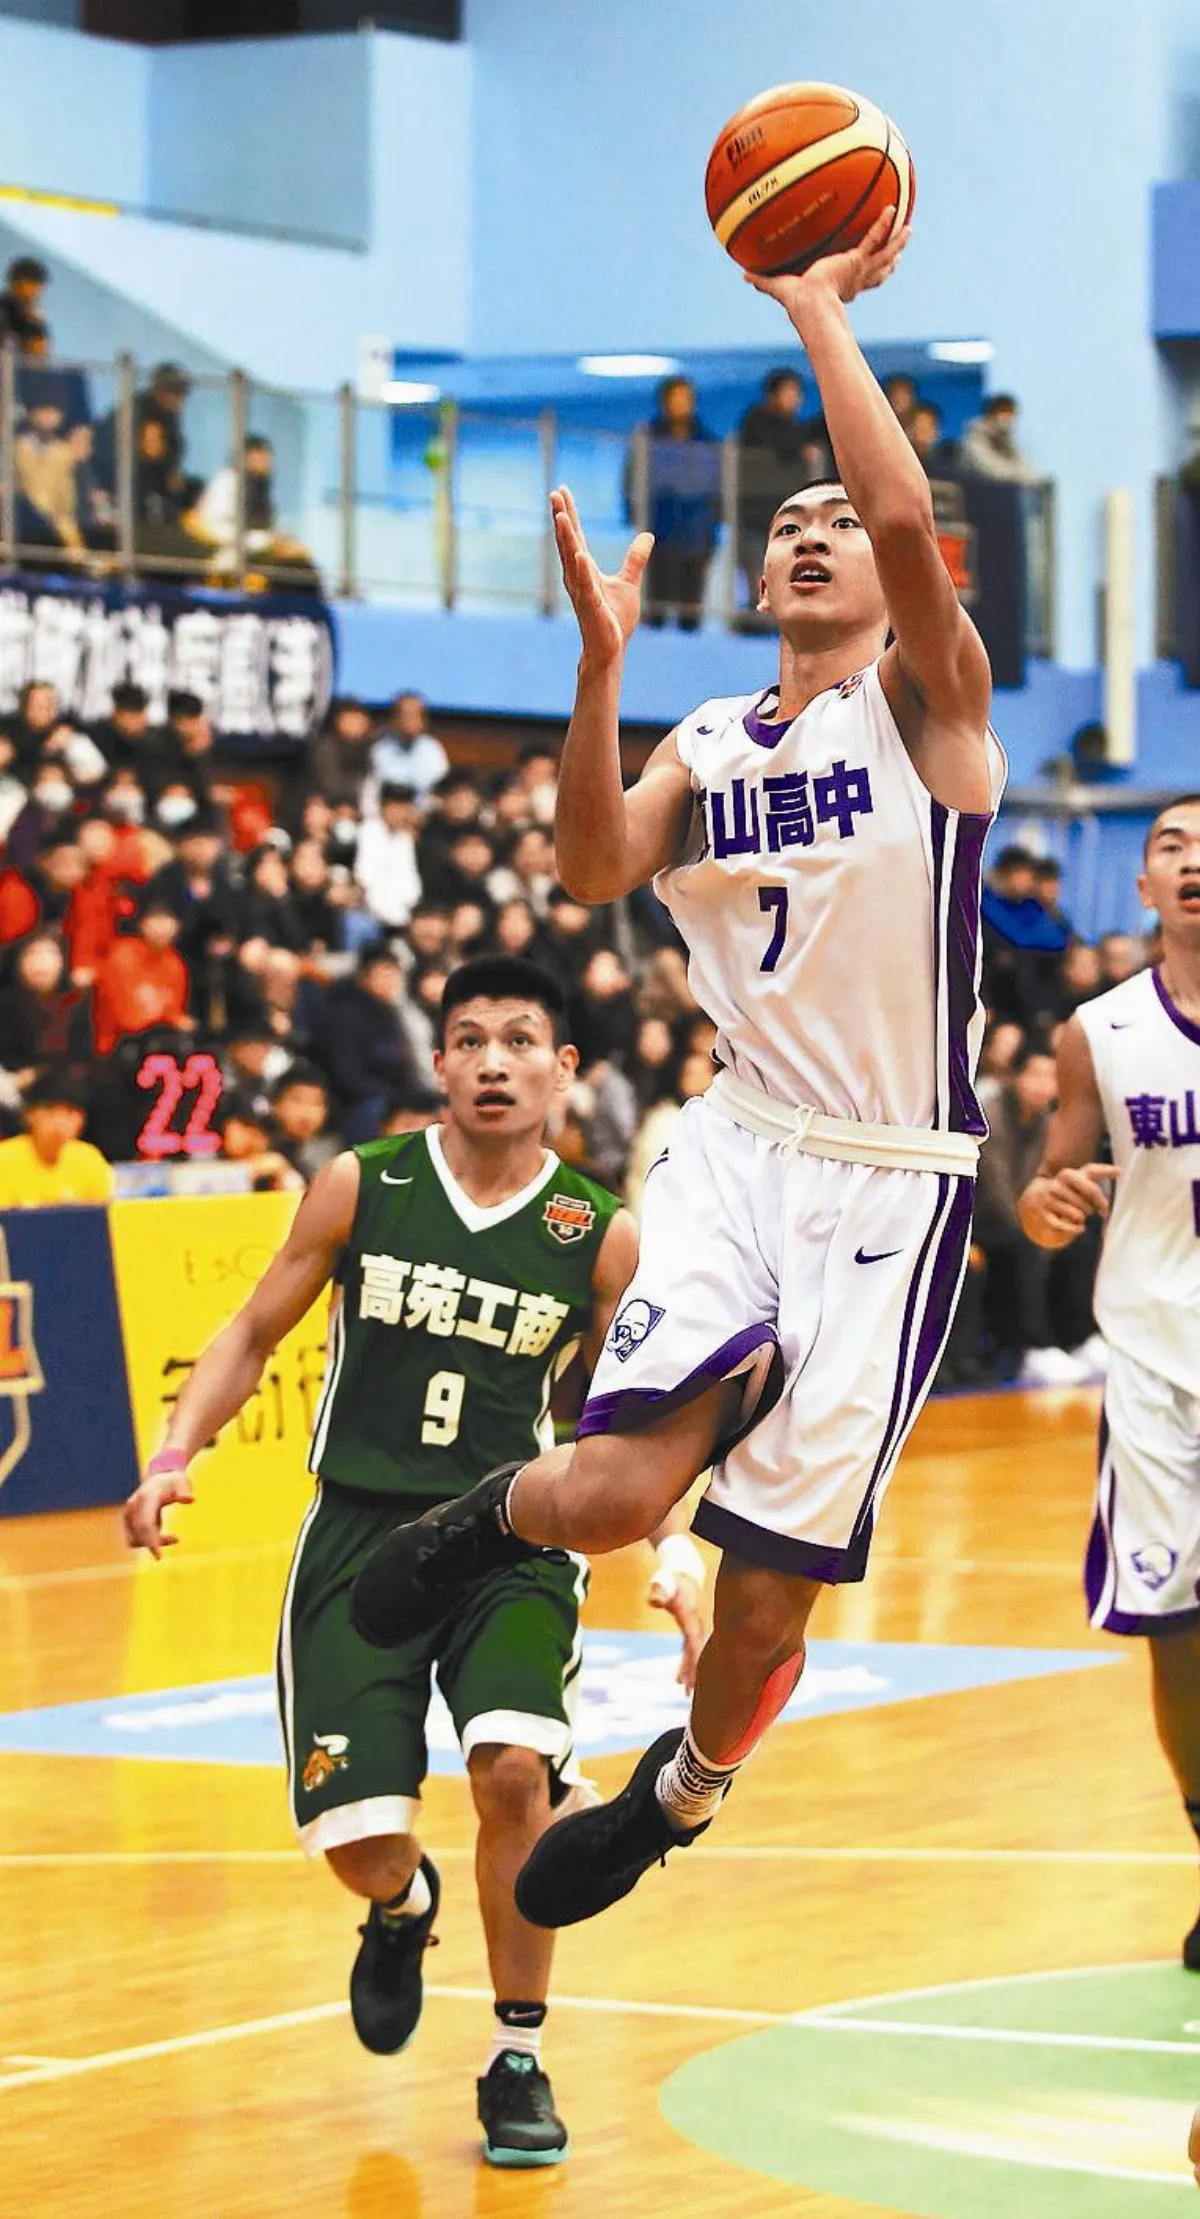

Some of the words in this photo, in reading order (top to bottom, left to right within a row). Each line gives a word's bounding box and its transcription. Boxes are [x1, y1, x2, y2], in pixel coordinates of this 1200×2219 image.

[701, 760, 873, 859] 山高中
[758, 887, 788, 972] 7
[136, 1054, 224, 1157] 22
[358, 1253, 570, 1358] 高苑工商
[421, 1370, 465, 1447] 9
